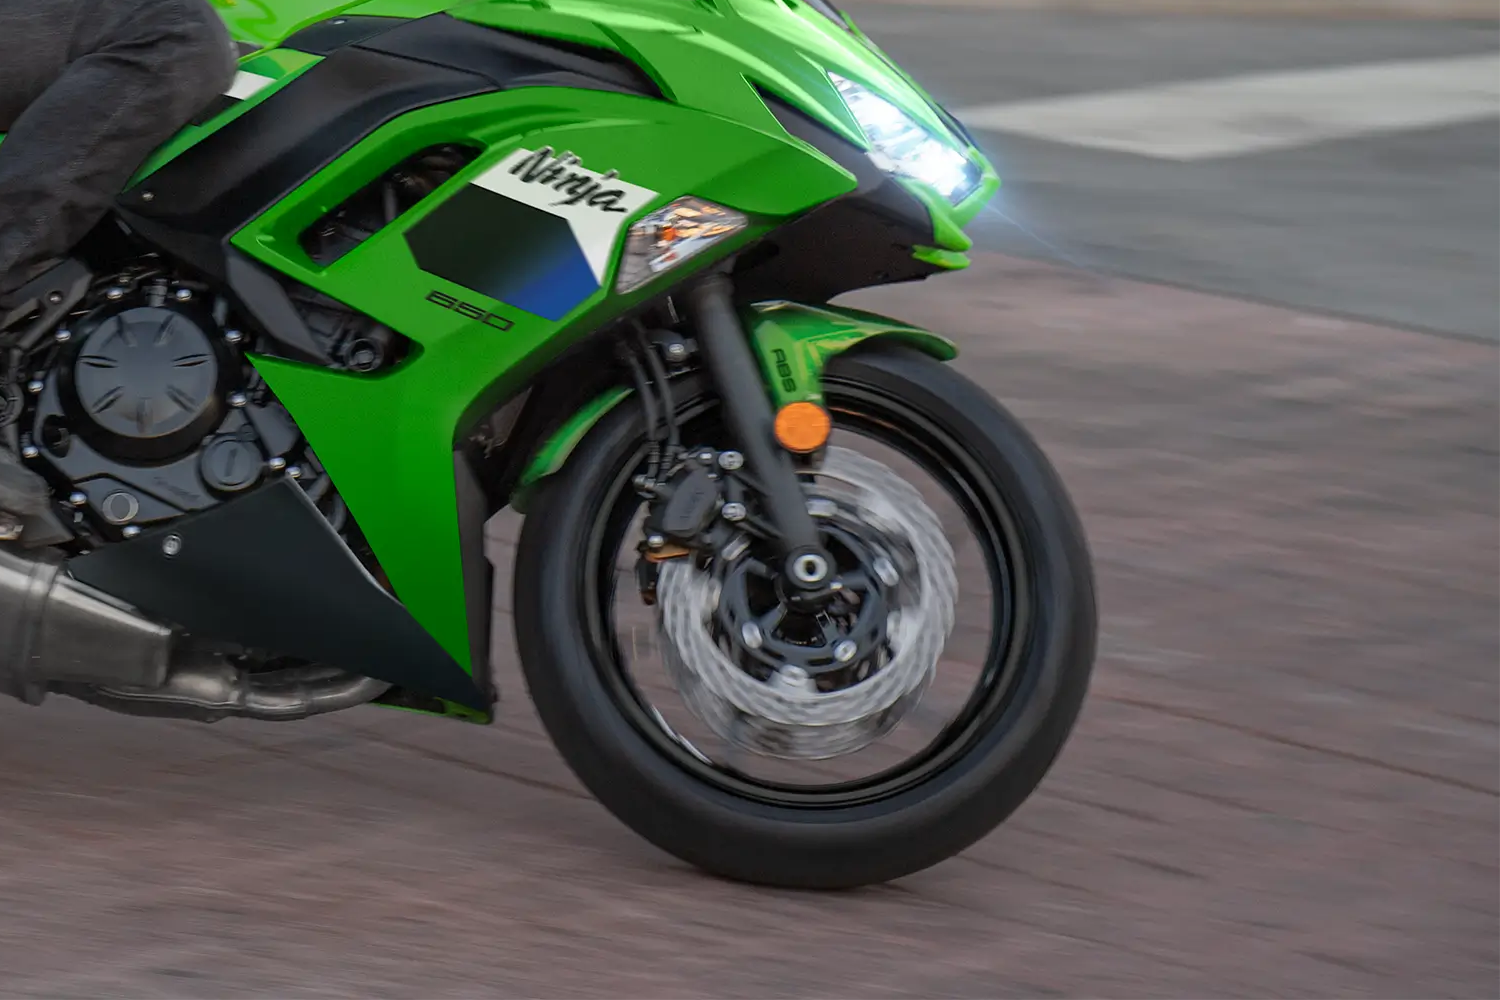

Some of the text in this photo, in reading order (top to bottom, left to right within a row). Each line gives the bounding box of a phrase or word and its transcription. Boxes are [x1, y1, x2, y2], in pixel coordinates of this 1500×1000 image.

[508, 146, 628, 212] Ninja
[424, 289, 515, 332] 650
[770, 348, 797, 393] ABS
